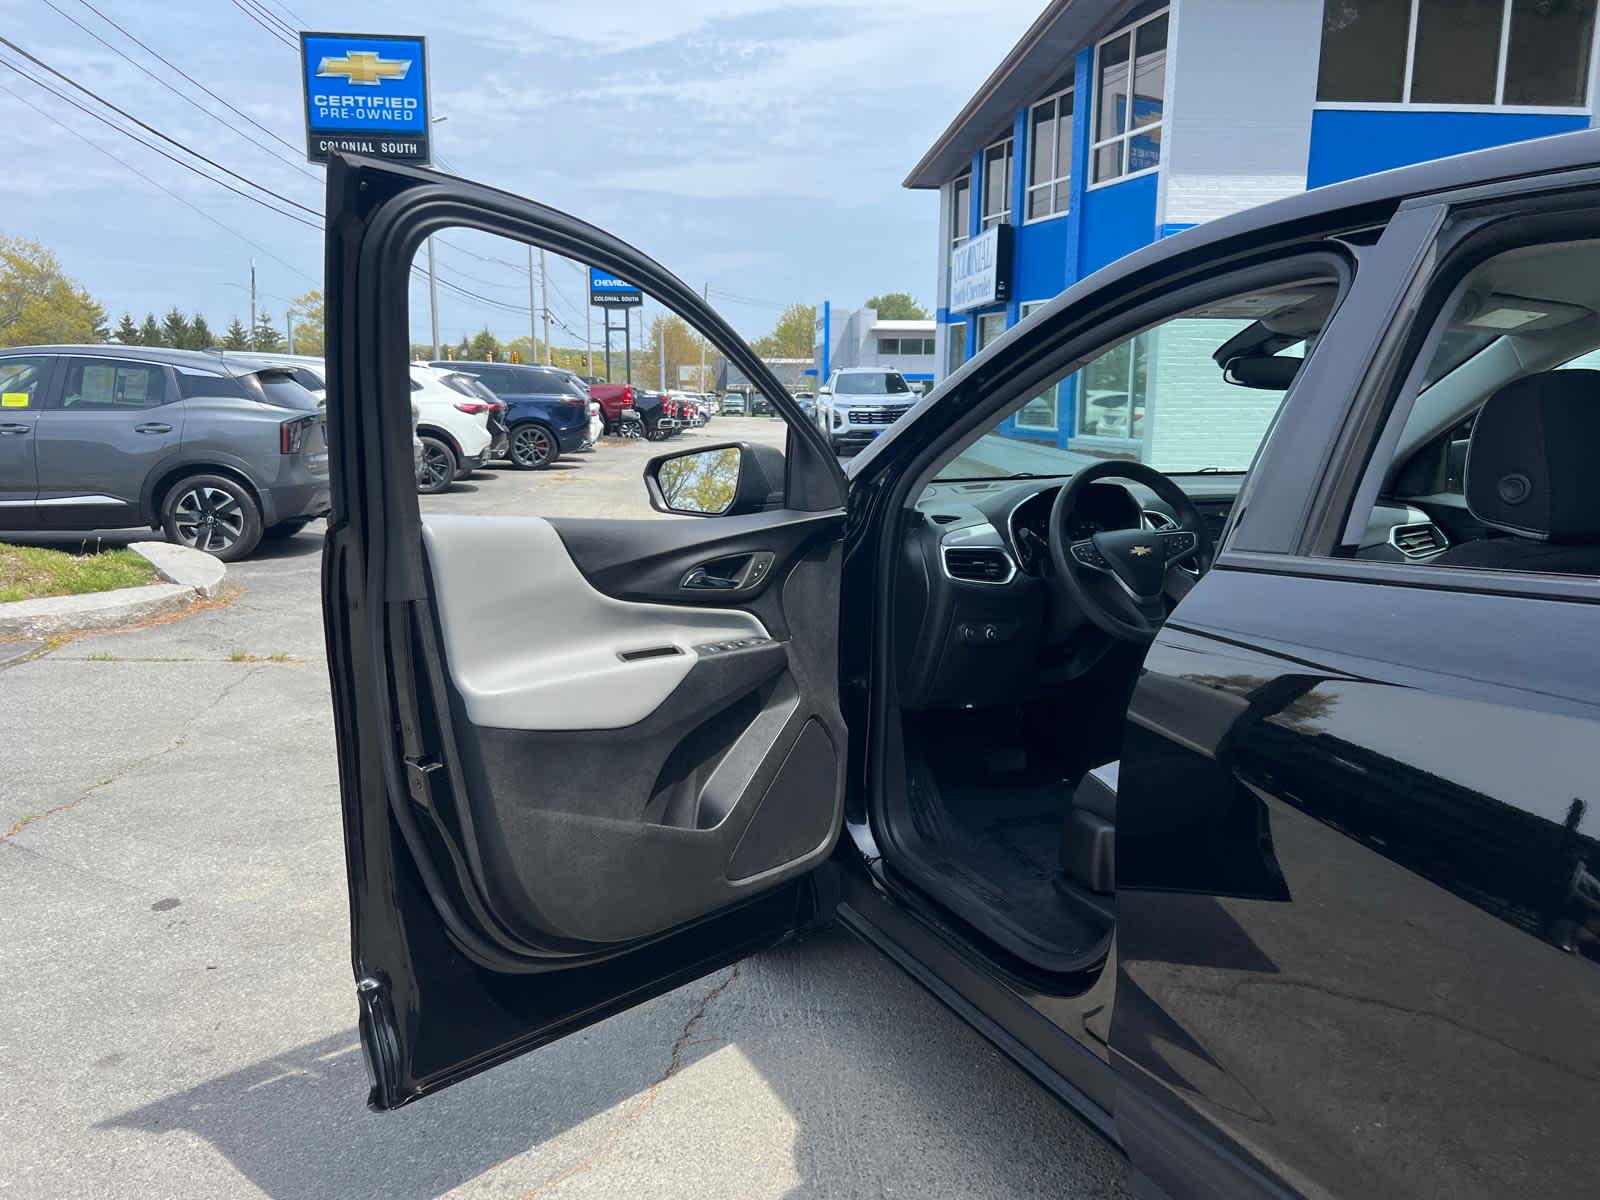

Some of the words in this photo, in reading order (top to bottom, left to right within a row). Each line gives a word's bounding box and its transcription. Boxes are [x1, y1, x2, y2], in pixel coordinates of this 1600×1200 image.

[314, 94, 418, 109] CERTIFIED
[319, 107, 413, 121] PRE-OWNED
[381, 142, 417, 154] SOUTH
